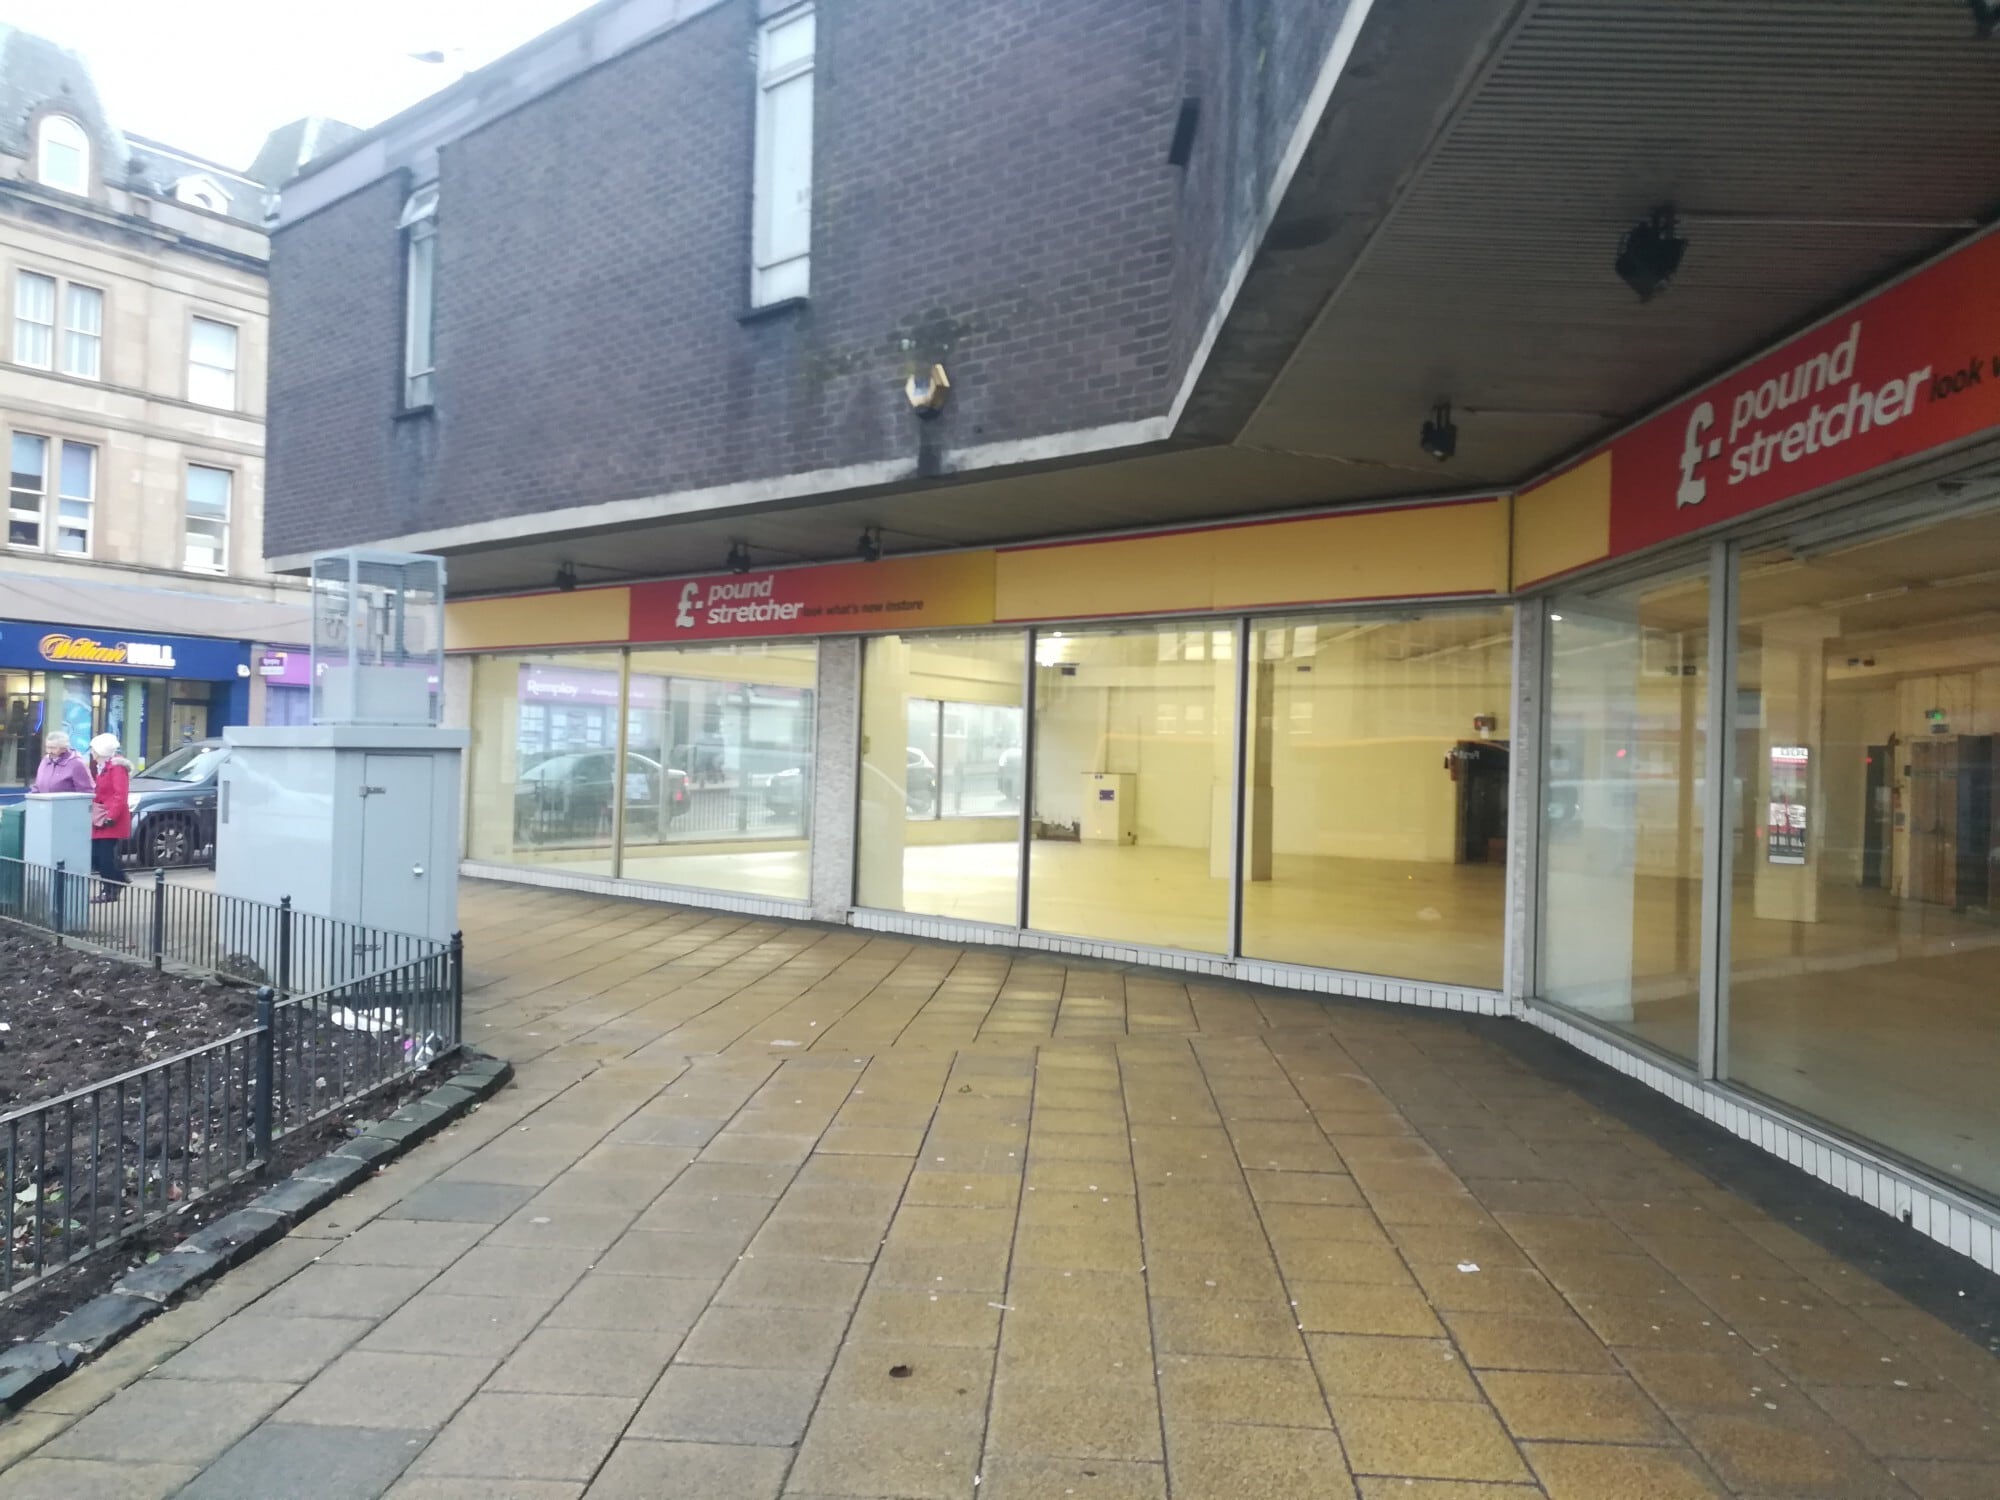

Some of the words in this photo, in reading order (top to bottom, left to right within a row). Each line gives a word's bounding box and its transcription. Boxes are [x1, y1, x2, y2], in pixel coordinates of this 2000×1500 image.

[1728, 319, 1862, 445] pound
[1929, 355, 1984, 403] look
[1727, 364, 1933, 486] stretcher
[707, 574, 774, 606] pound
[706, 599, 804, 625] stretcher
[39, 634, 128, 664] William
